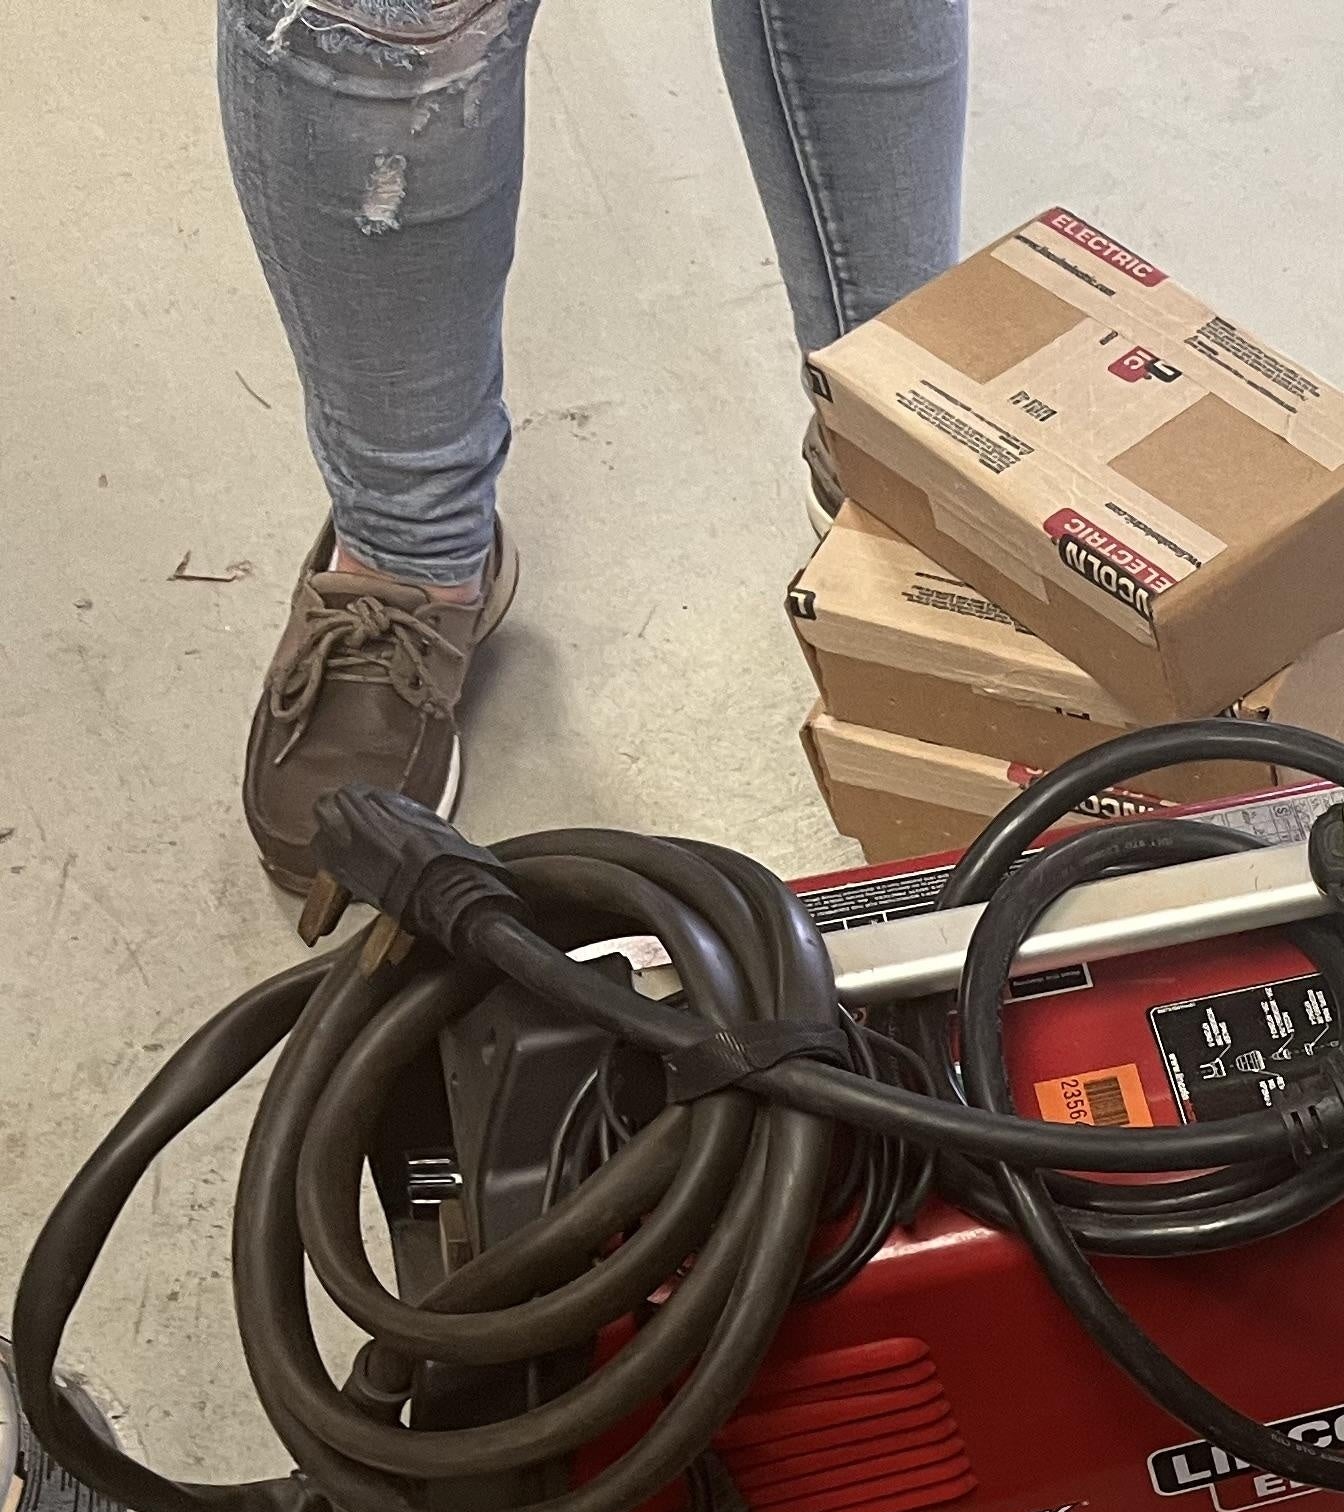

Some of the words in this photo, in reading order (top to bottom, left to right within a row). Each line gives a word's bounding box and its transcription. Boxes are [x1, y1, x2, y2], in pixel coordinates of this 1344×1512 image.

[1051, 212, 1154, 279] ELECTRIC
[1063, 518, 1174, 594] ELECTRIC
[1065, 541, 1152, 619] NCOLN
[1061, 1078, 1088, 1123] 2356
